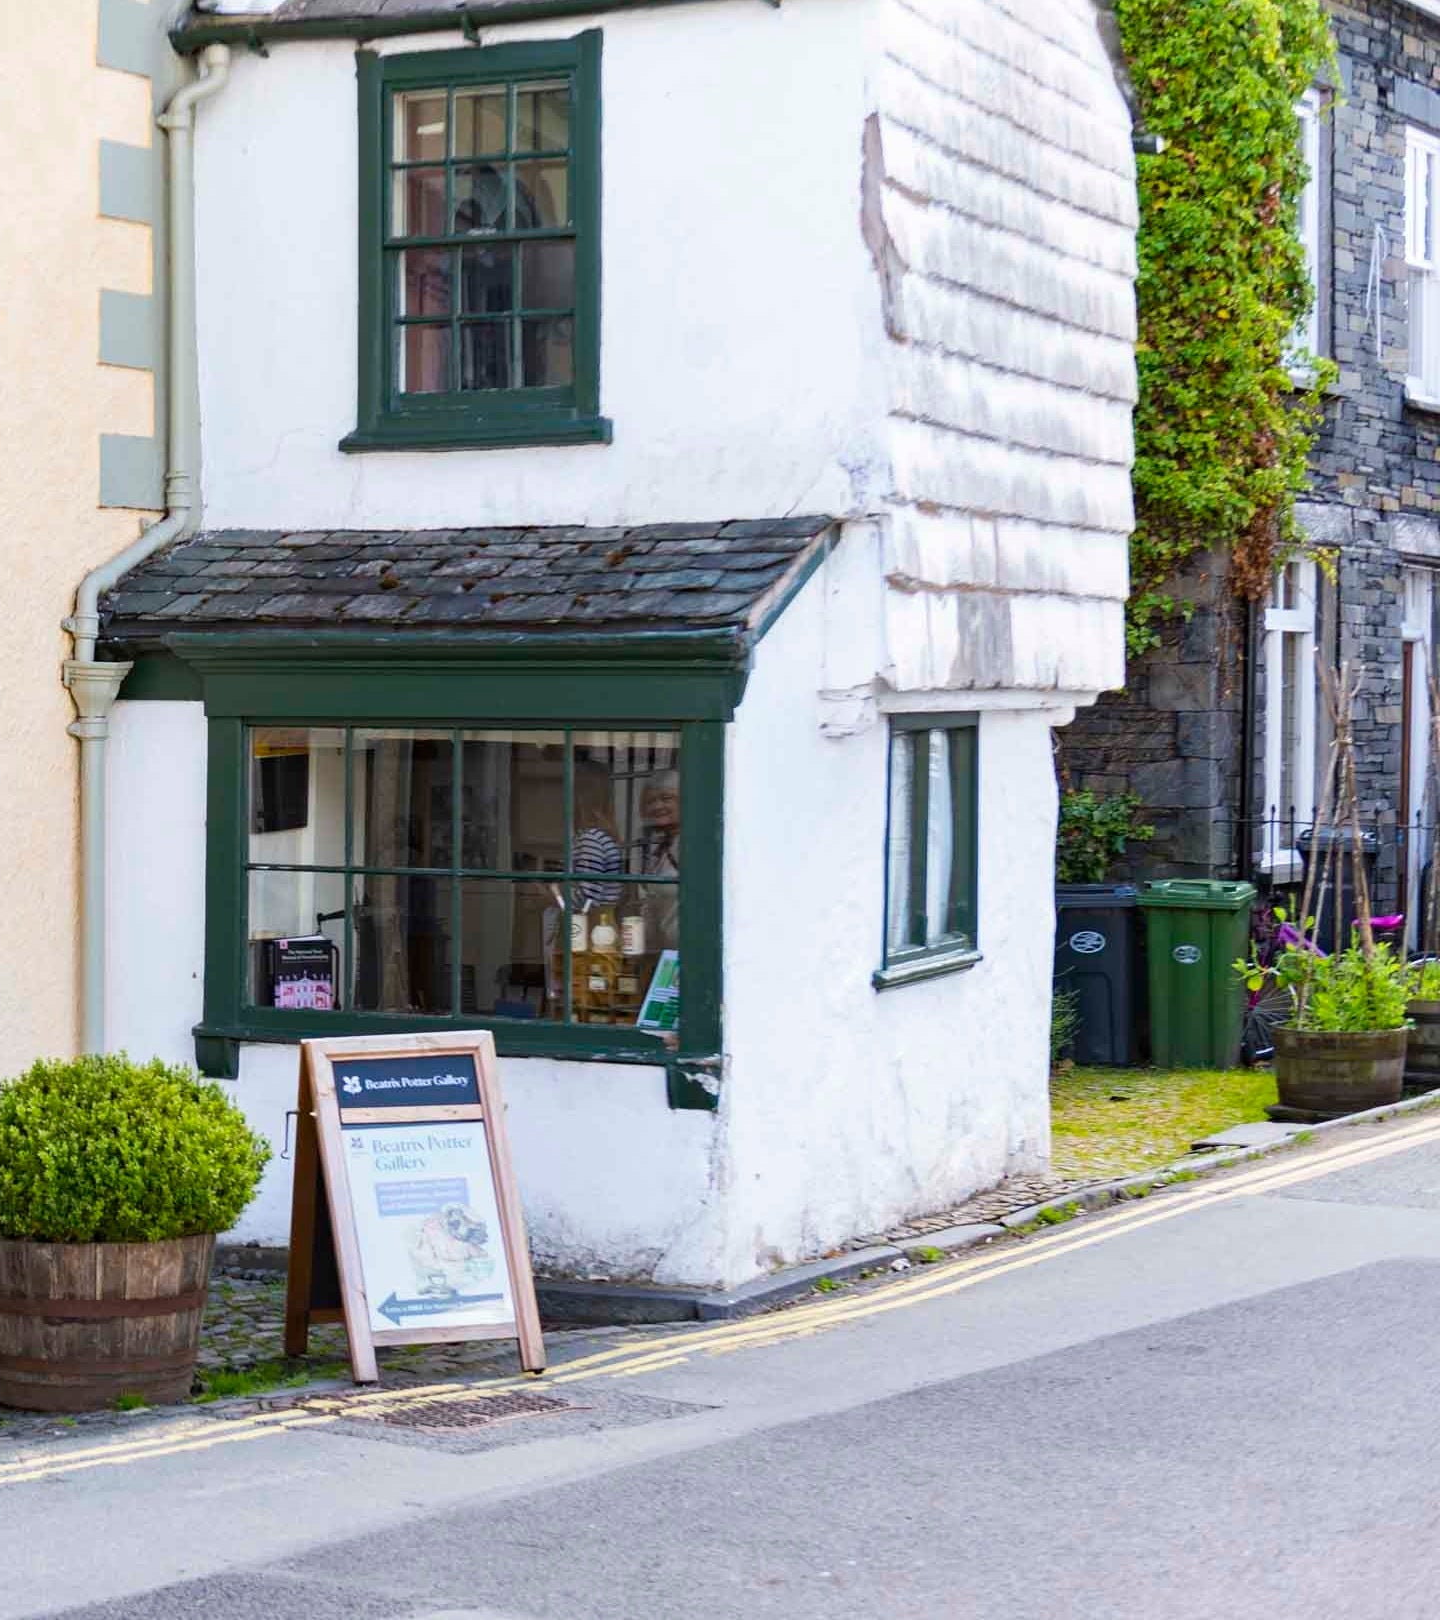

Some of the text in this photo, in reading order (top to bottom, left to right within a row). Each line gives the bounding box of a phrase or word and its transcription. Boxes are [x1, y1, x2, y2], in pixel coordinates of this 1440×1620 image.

[364, 1073, 469, 1091] Beatrix Potter Gallery
[371, 1134, 473, 1154] Beatrix Potter
[374, 1154, 426, 1172] Gallery
